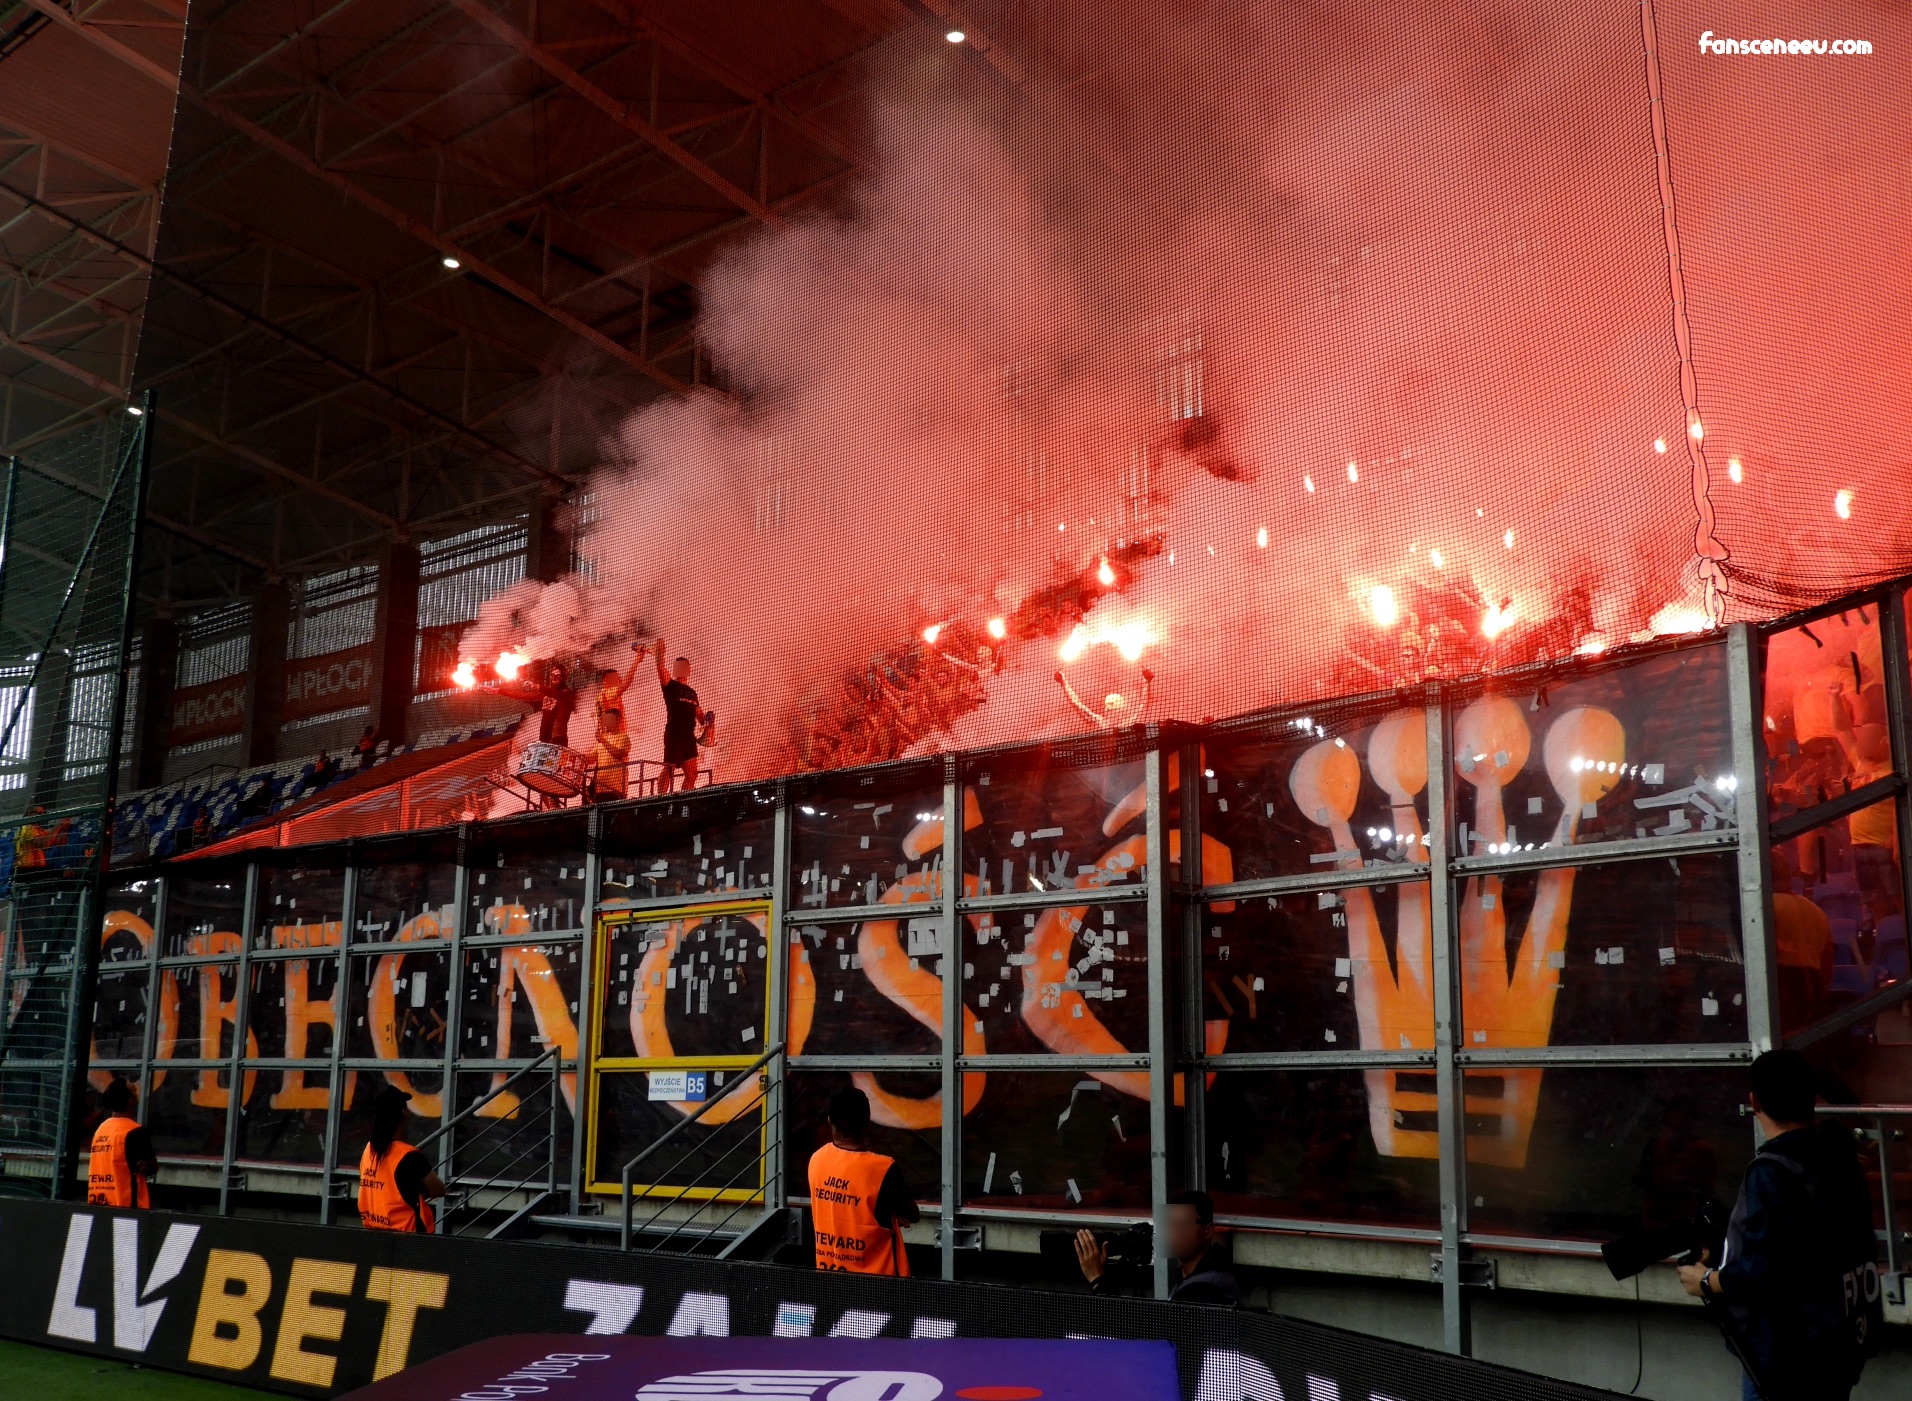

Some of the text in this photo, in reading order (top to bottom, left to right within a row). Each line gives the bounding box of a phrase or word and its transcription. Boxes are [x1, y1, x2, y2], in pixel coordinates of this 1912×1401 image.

[655, 1077, 705, 1094] WYJŚCIE B5
[824, 1176, 850, 1190] JACK
[815, 1231, 866, 1252] TEWARD
[47, 1213, 200, 1352] LV
[188, 1247, 450, 1388] BET
[496, 1353, 611, 1383] Bank
